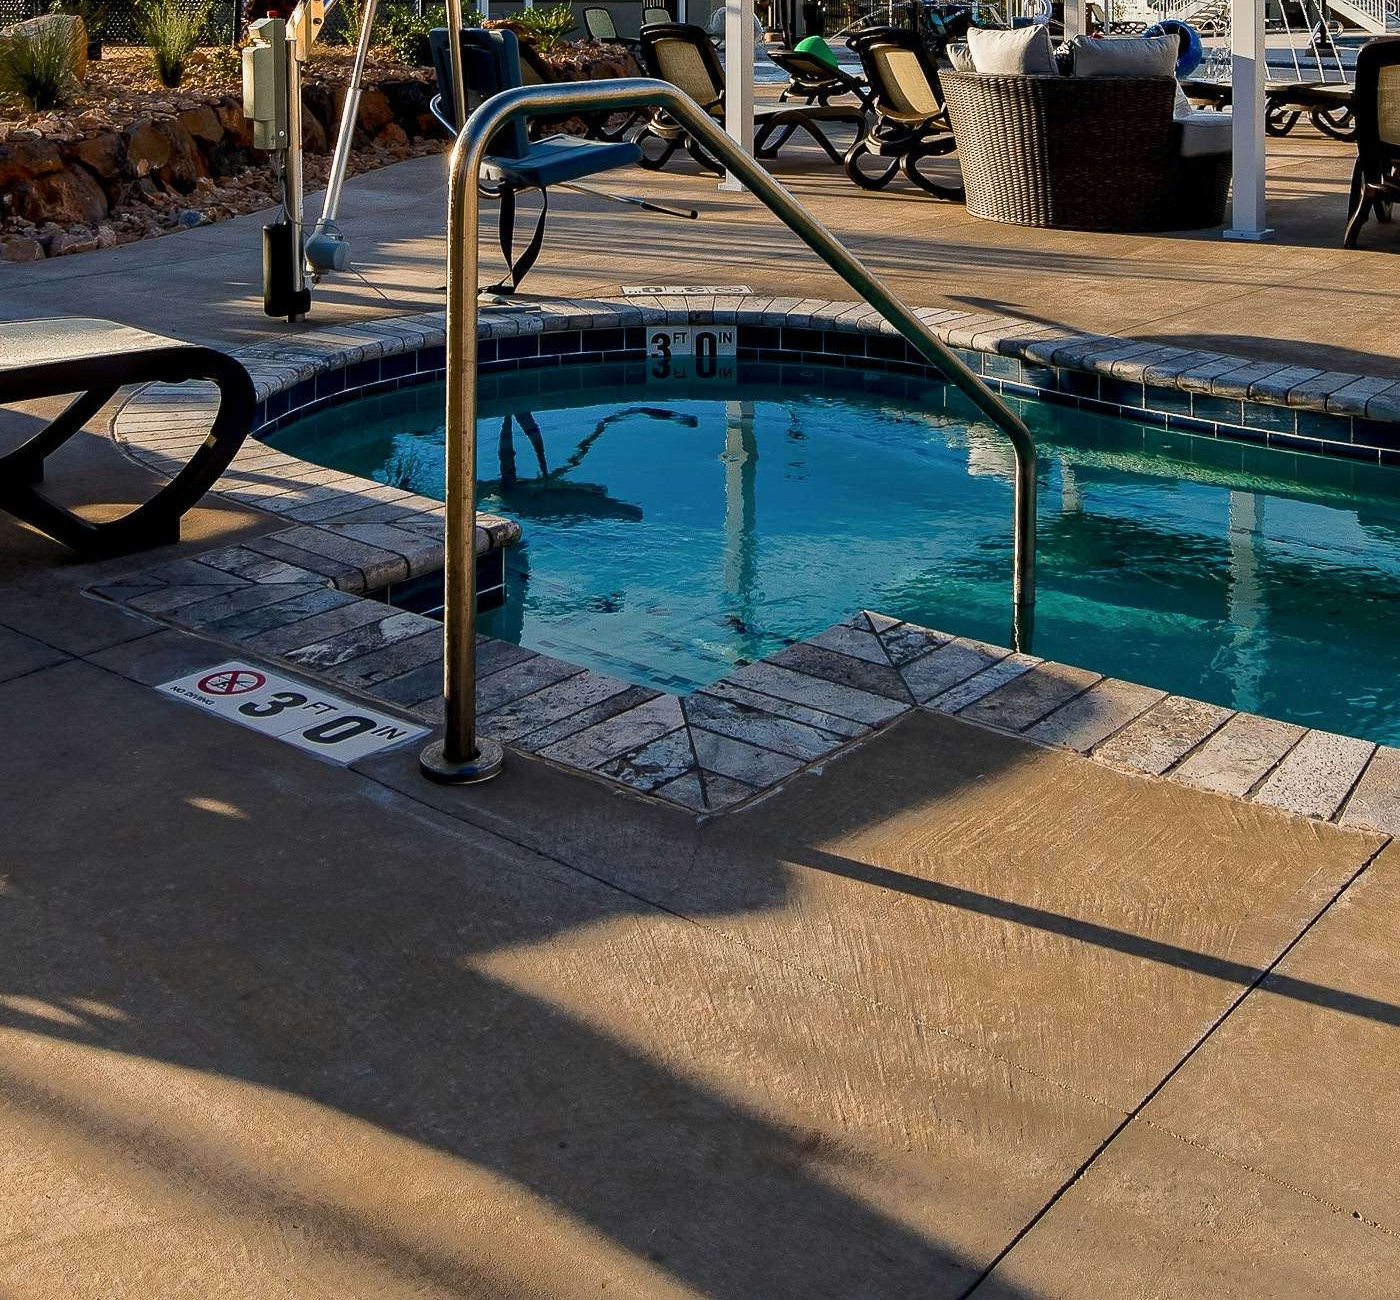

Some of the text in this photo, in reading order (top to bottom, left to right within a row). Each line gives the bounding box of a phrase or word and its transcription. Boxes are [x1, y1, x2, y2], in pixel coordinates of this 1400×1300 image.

[651, 332, 733, 358] 3 FT 0 IN
[170, 686, 215, 706] NO DIVING
[238, 692, 408, 744] 3 FT 0 IN
